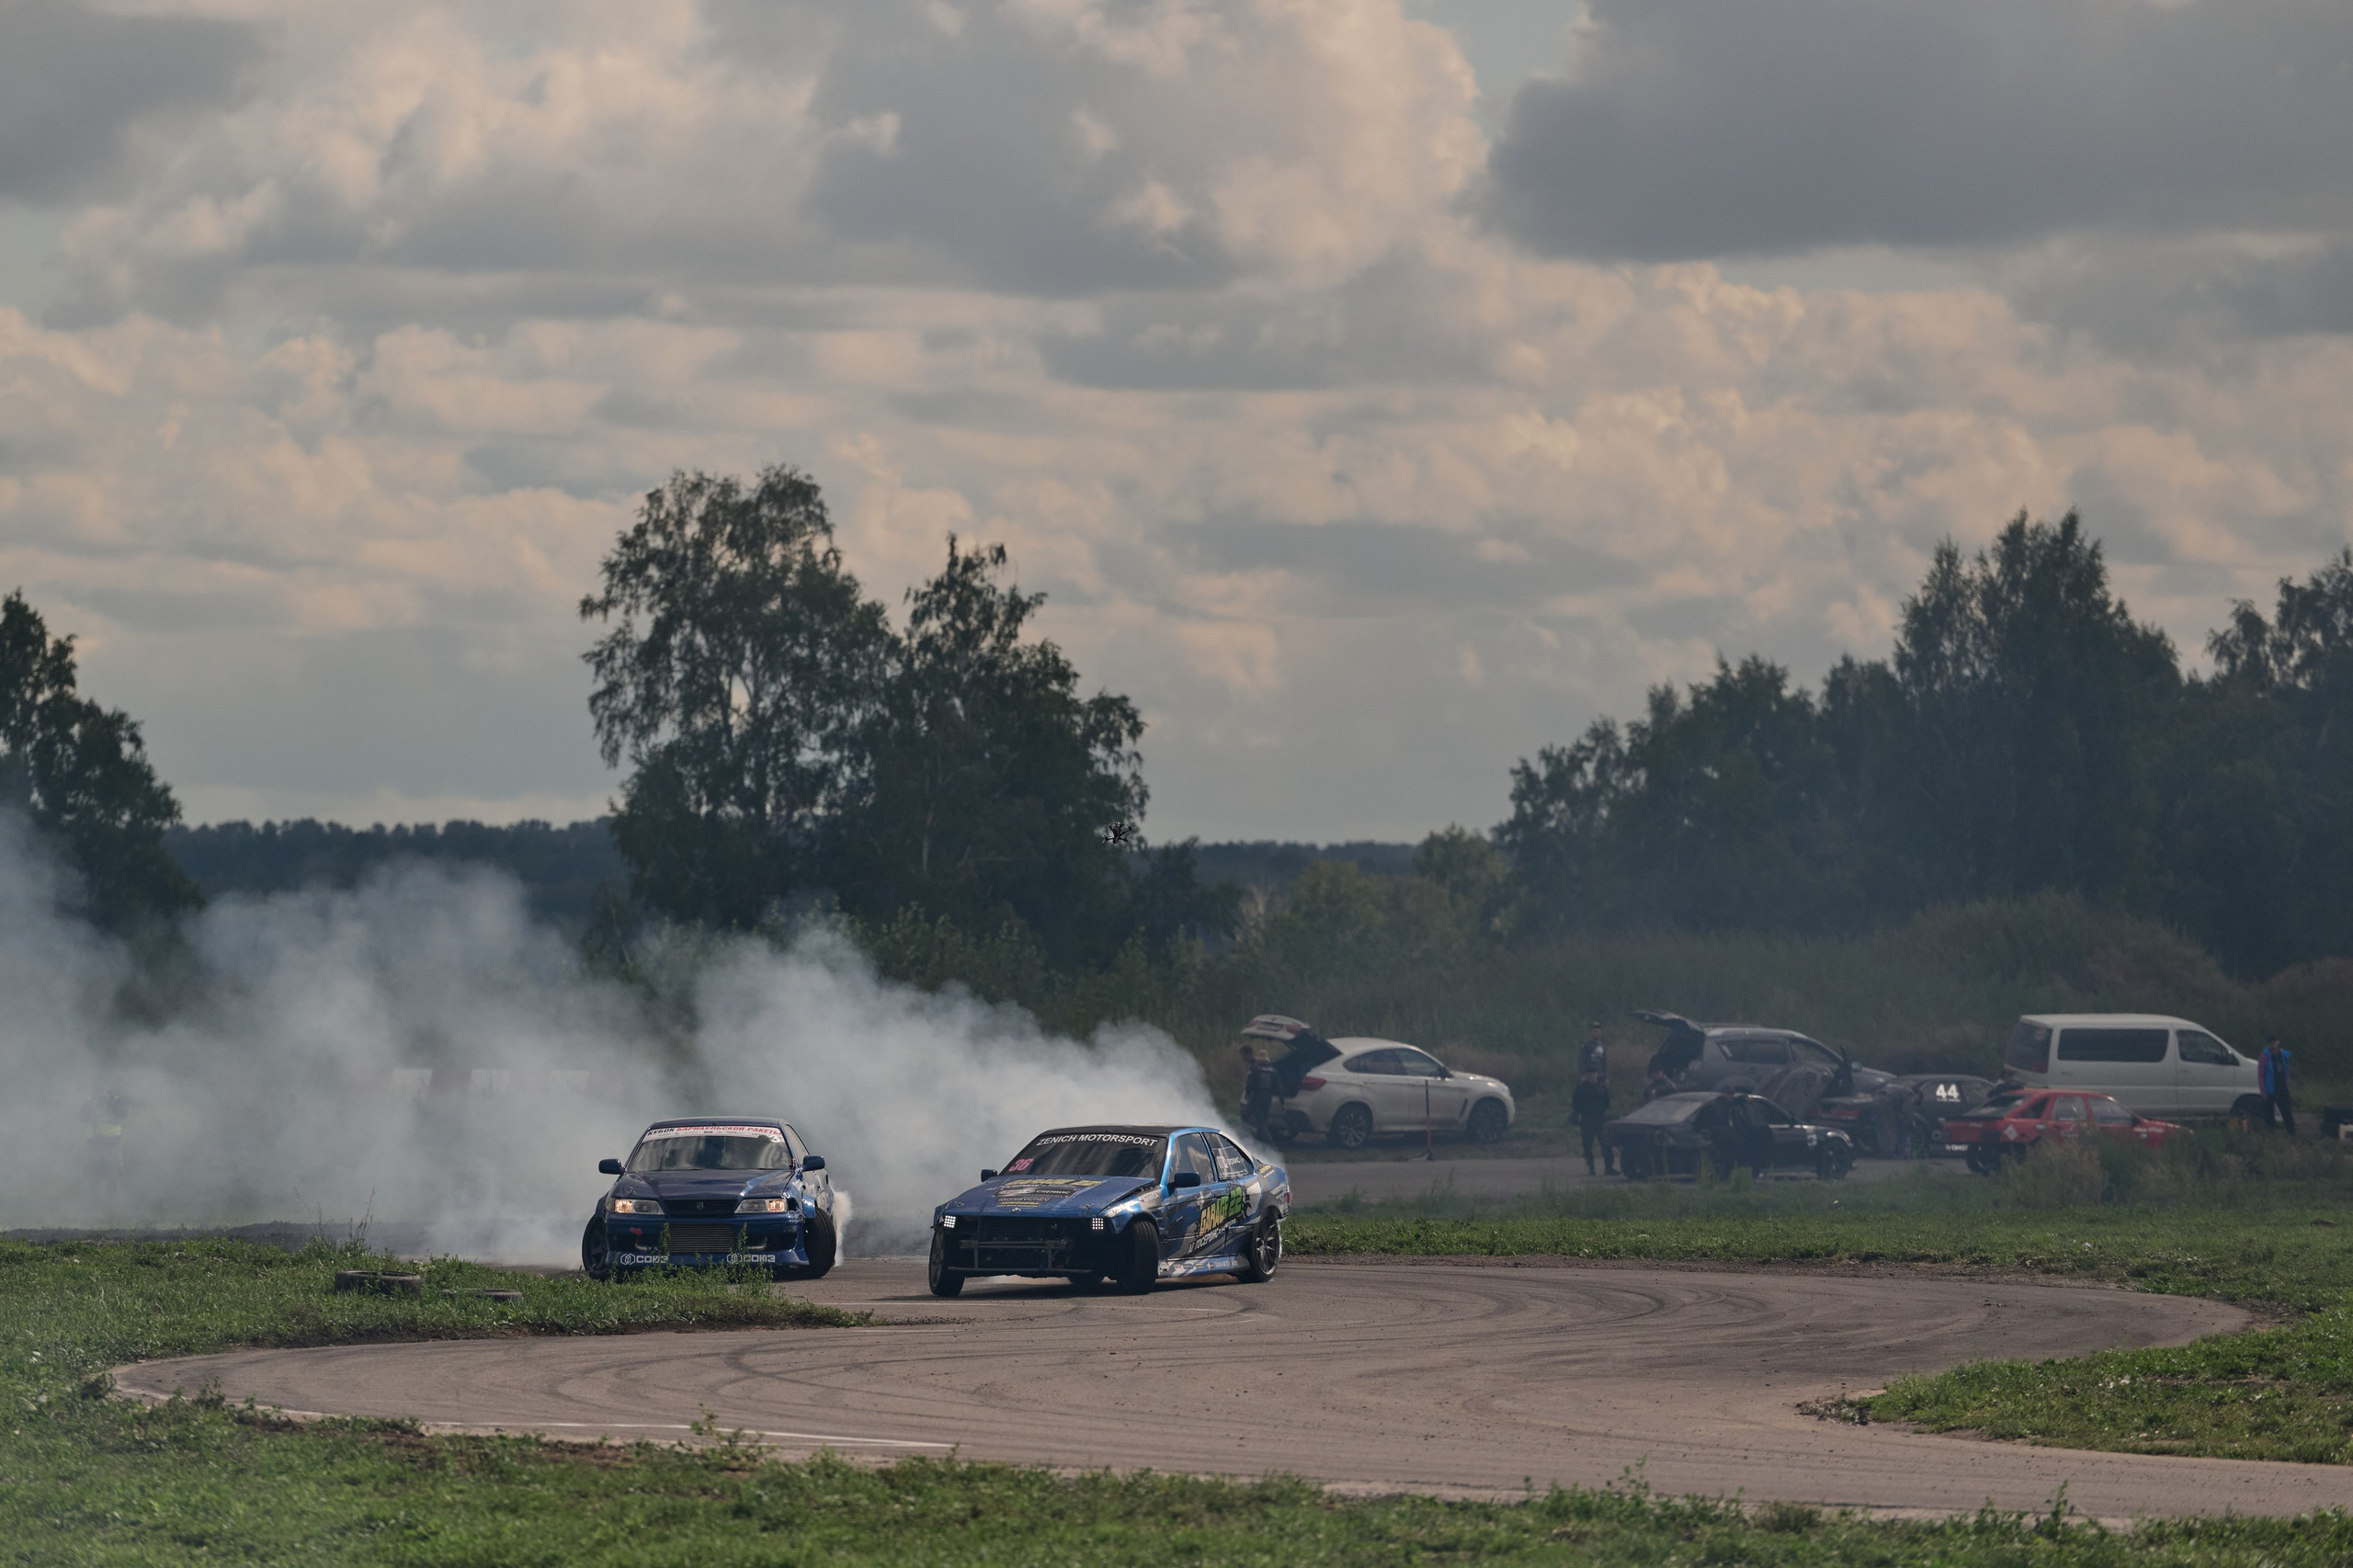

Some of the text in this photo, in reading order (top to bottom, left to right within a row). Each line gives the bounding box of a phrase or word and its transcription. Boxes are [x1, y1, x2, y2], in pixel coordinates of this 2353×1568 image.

[1935, 1084, 1960, 1099] 44
[647, 1128, 676, 1136] КУБОК
[1036, 1133, 1158, 1147] ZENICH MOTORSPORT
[1008, 1158, 1034, 1172] 36
[1199, 1187, 1243, 1237] GARAGE 22
